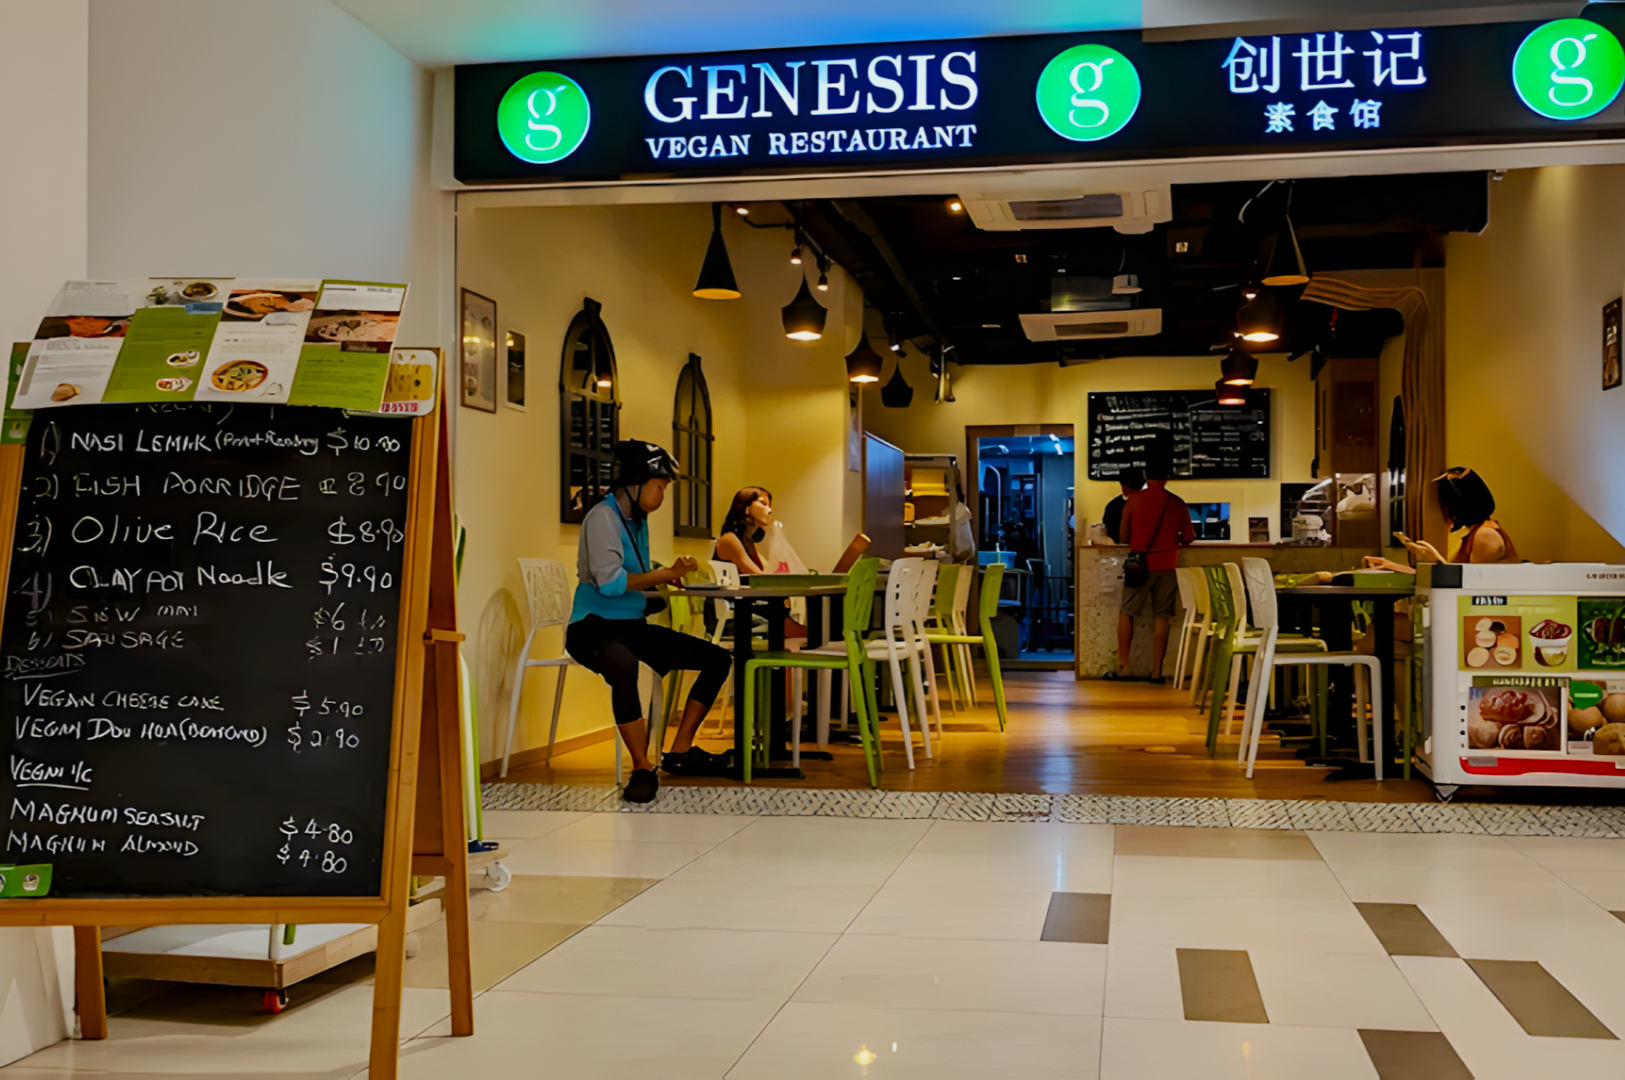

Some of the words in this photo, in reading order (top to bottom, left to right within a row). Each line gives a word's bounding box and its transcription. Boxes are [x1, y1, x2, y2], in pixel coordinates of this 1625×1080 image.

[1222, 31, 1427, 94] 创世记
[643, 51, 978, 124] GENESIS
[1264, 98, 1383, 134] 素食馆
[644, 134, 751, 160] VEGAN
[768, 124, 978, 155] RESTAURANT
[71, 432, 123, 452] NASI
[73, 472, 141, 497] FISH
[163, 471, 300, 501] PORRIDGE
[72, 514, 174, 545] Olive
[193, 511, 279, 545] Rice
[319, 552, 392, 595] $9.90
[25, 683, 95, 708] VEGAN
[10, 798, 118, 825] MAGNUM
